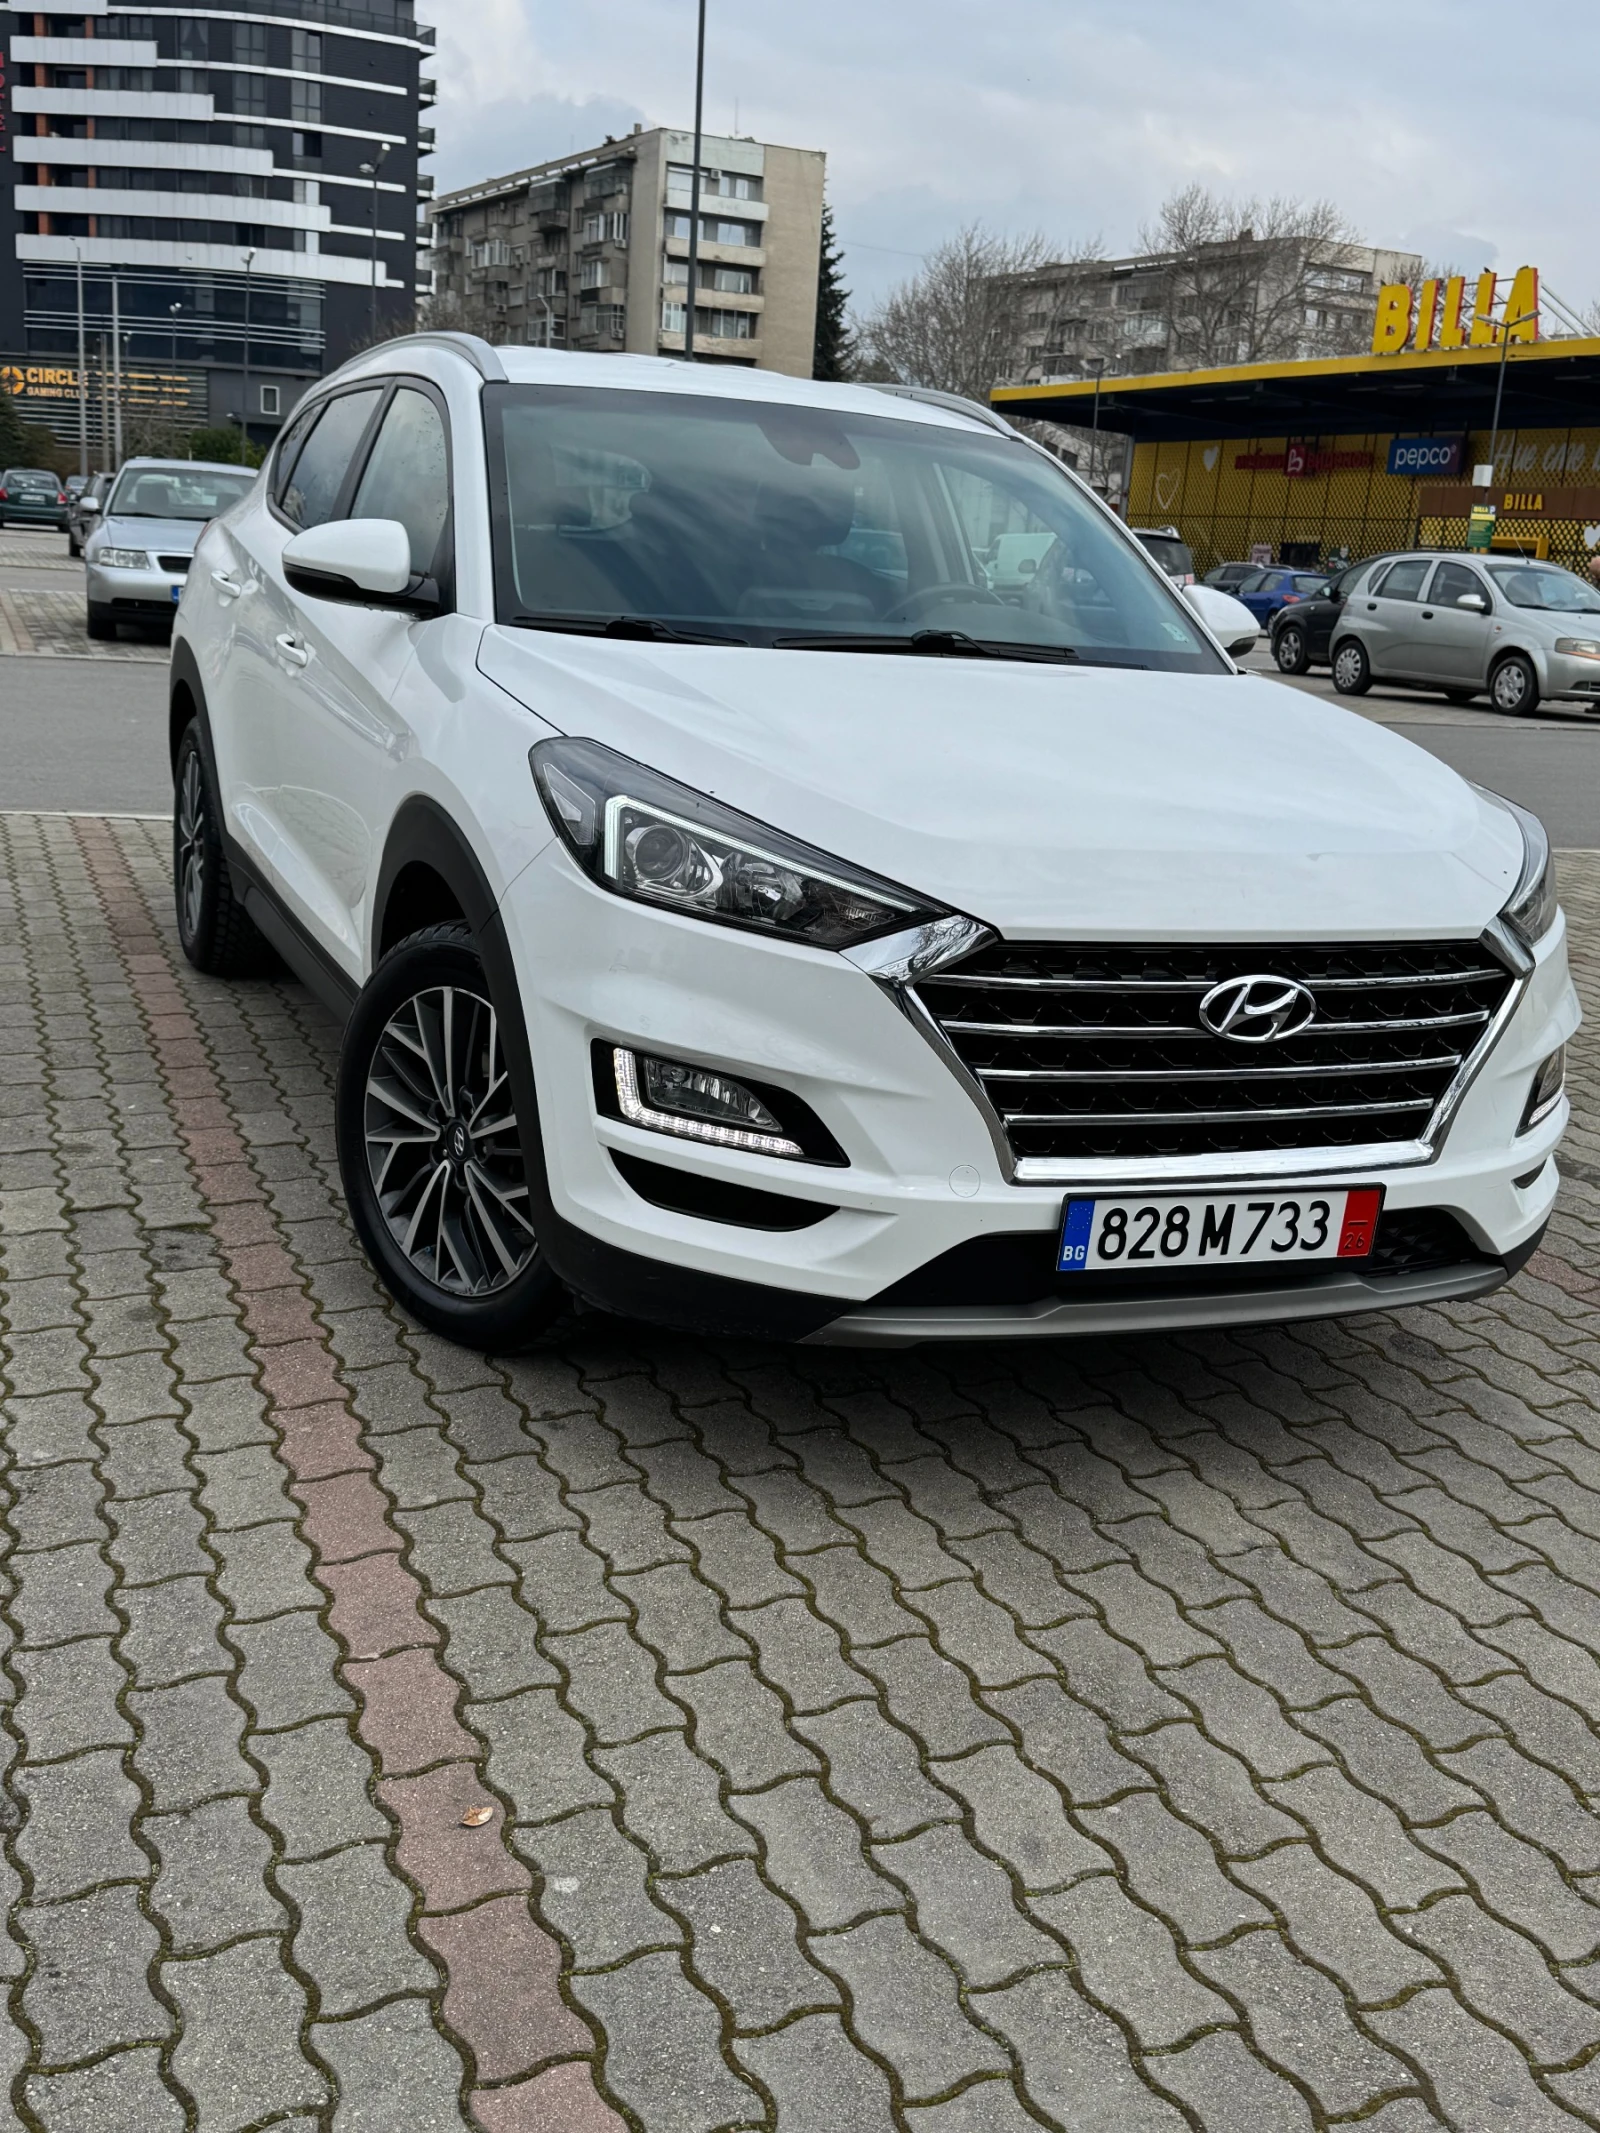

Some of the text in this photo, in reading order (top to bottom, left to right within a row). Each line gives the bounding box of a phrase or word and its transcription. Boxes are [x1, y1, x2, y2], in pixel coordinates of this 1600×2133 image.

[1371, 266, 1539, 353] BILLA
[27, 387, 63, 397] GAMING
[1394, 446, 1452, 468] pepco
[1503, 493, 1543, 511] BILLA
[1062, 1200, 1330, 1261] BG 828 M 733
[1343, 1231, 1365, 1249] 26
